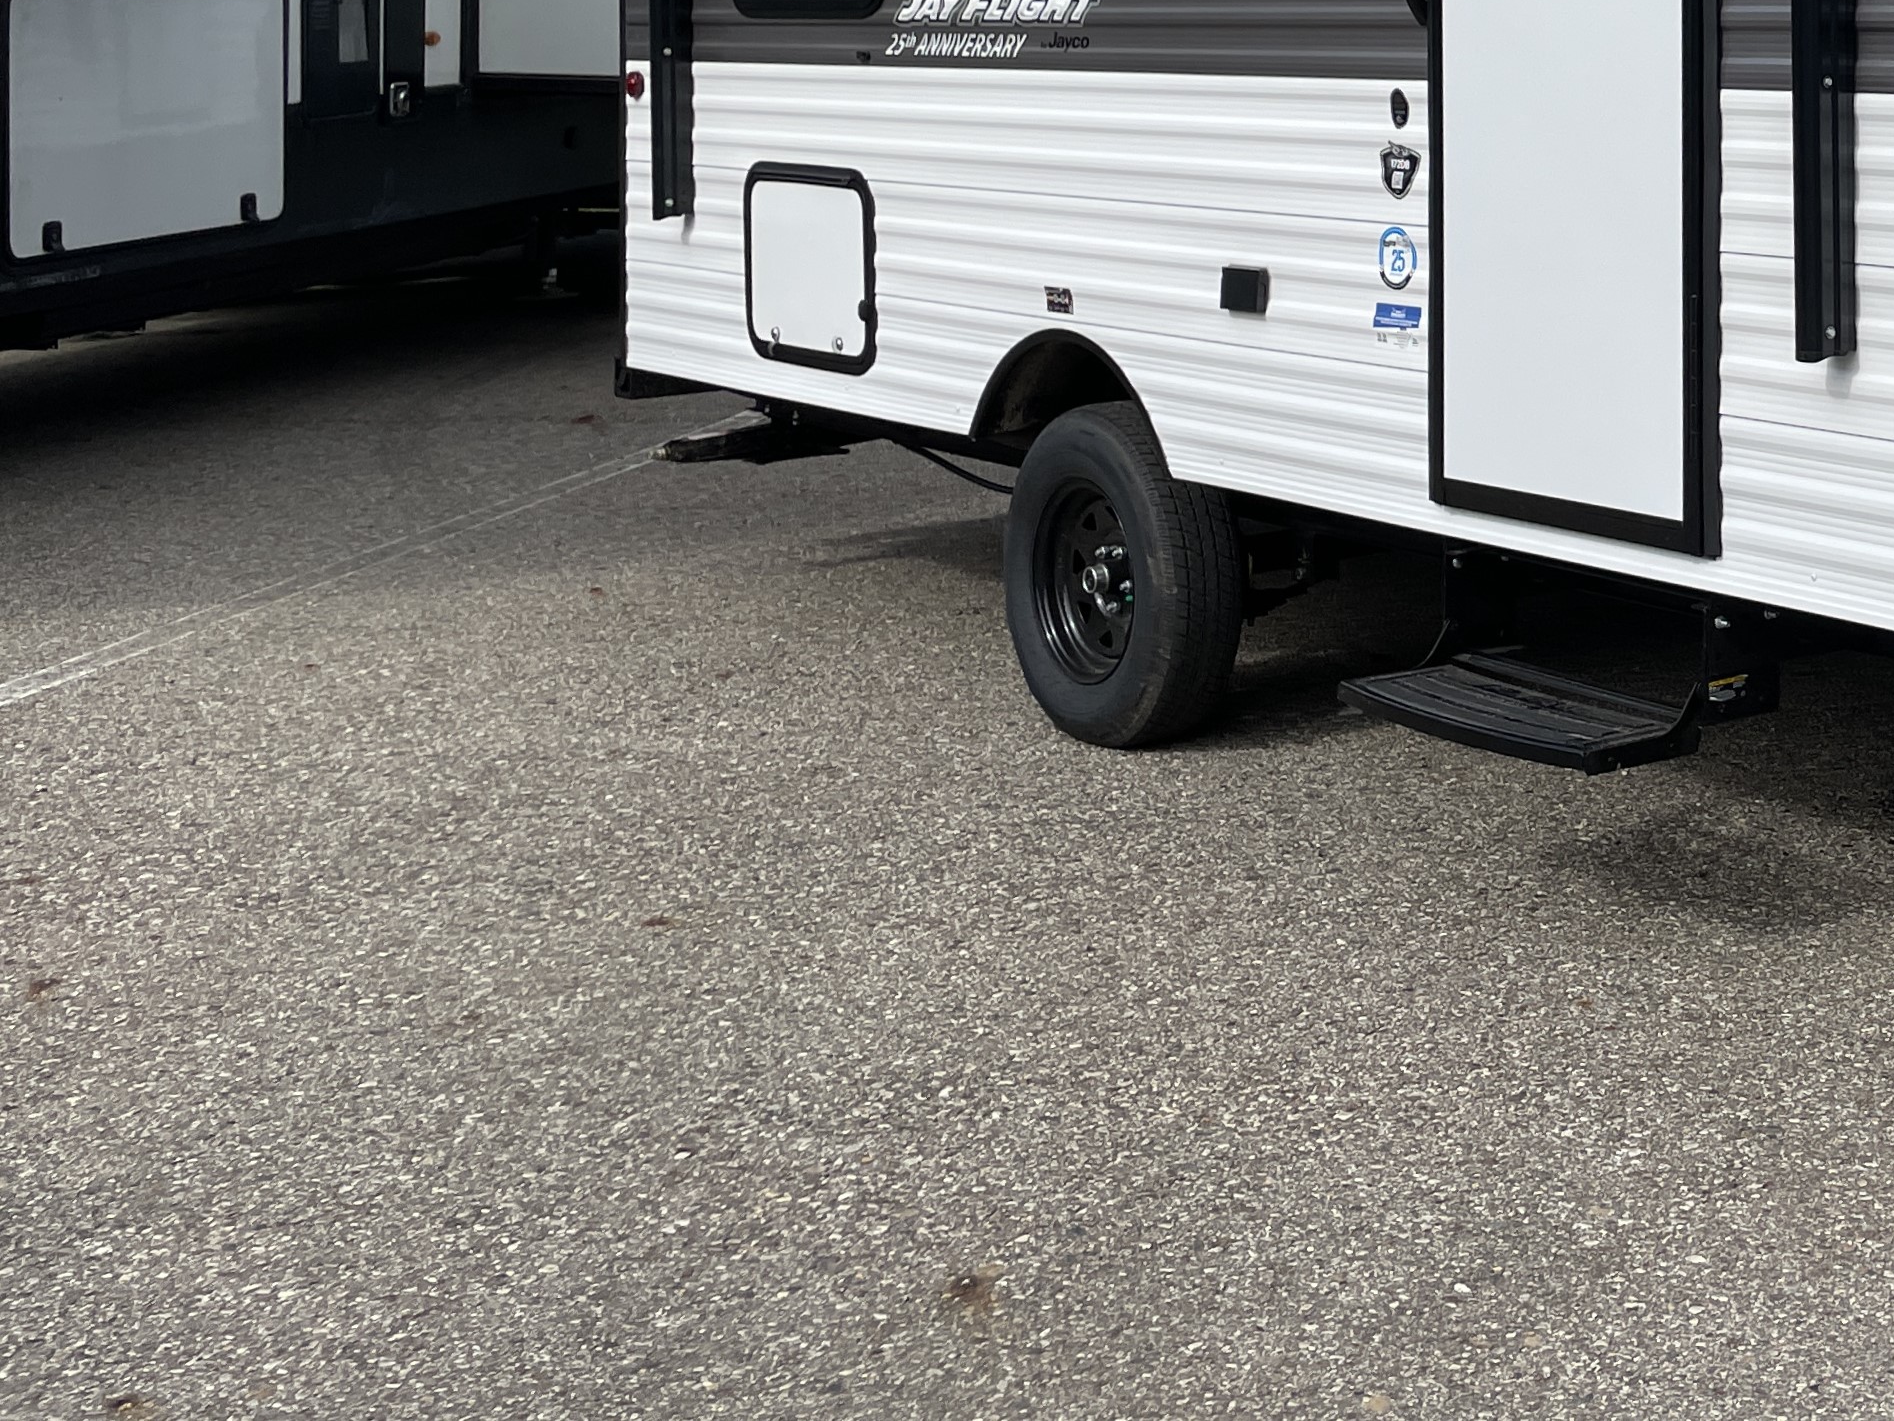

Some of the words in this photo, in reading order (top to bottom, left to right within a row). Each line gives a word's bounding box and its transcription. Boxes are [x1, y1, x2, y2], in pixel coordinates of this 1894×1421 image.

[885, 32, 917, 55] 25th
[914, 33, 1027, 58] ANNIVERSARY
[1048, 31, 1090, 54] Jayco
[1391, 249, 1406, 273] 25
